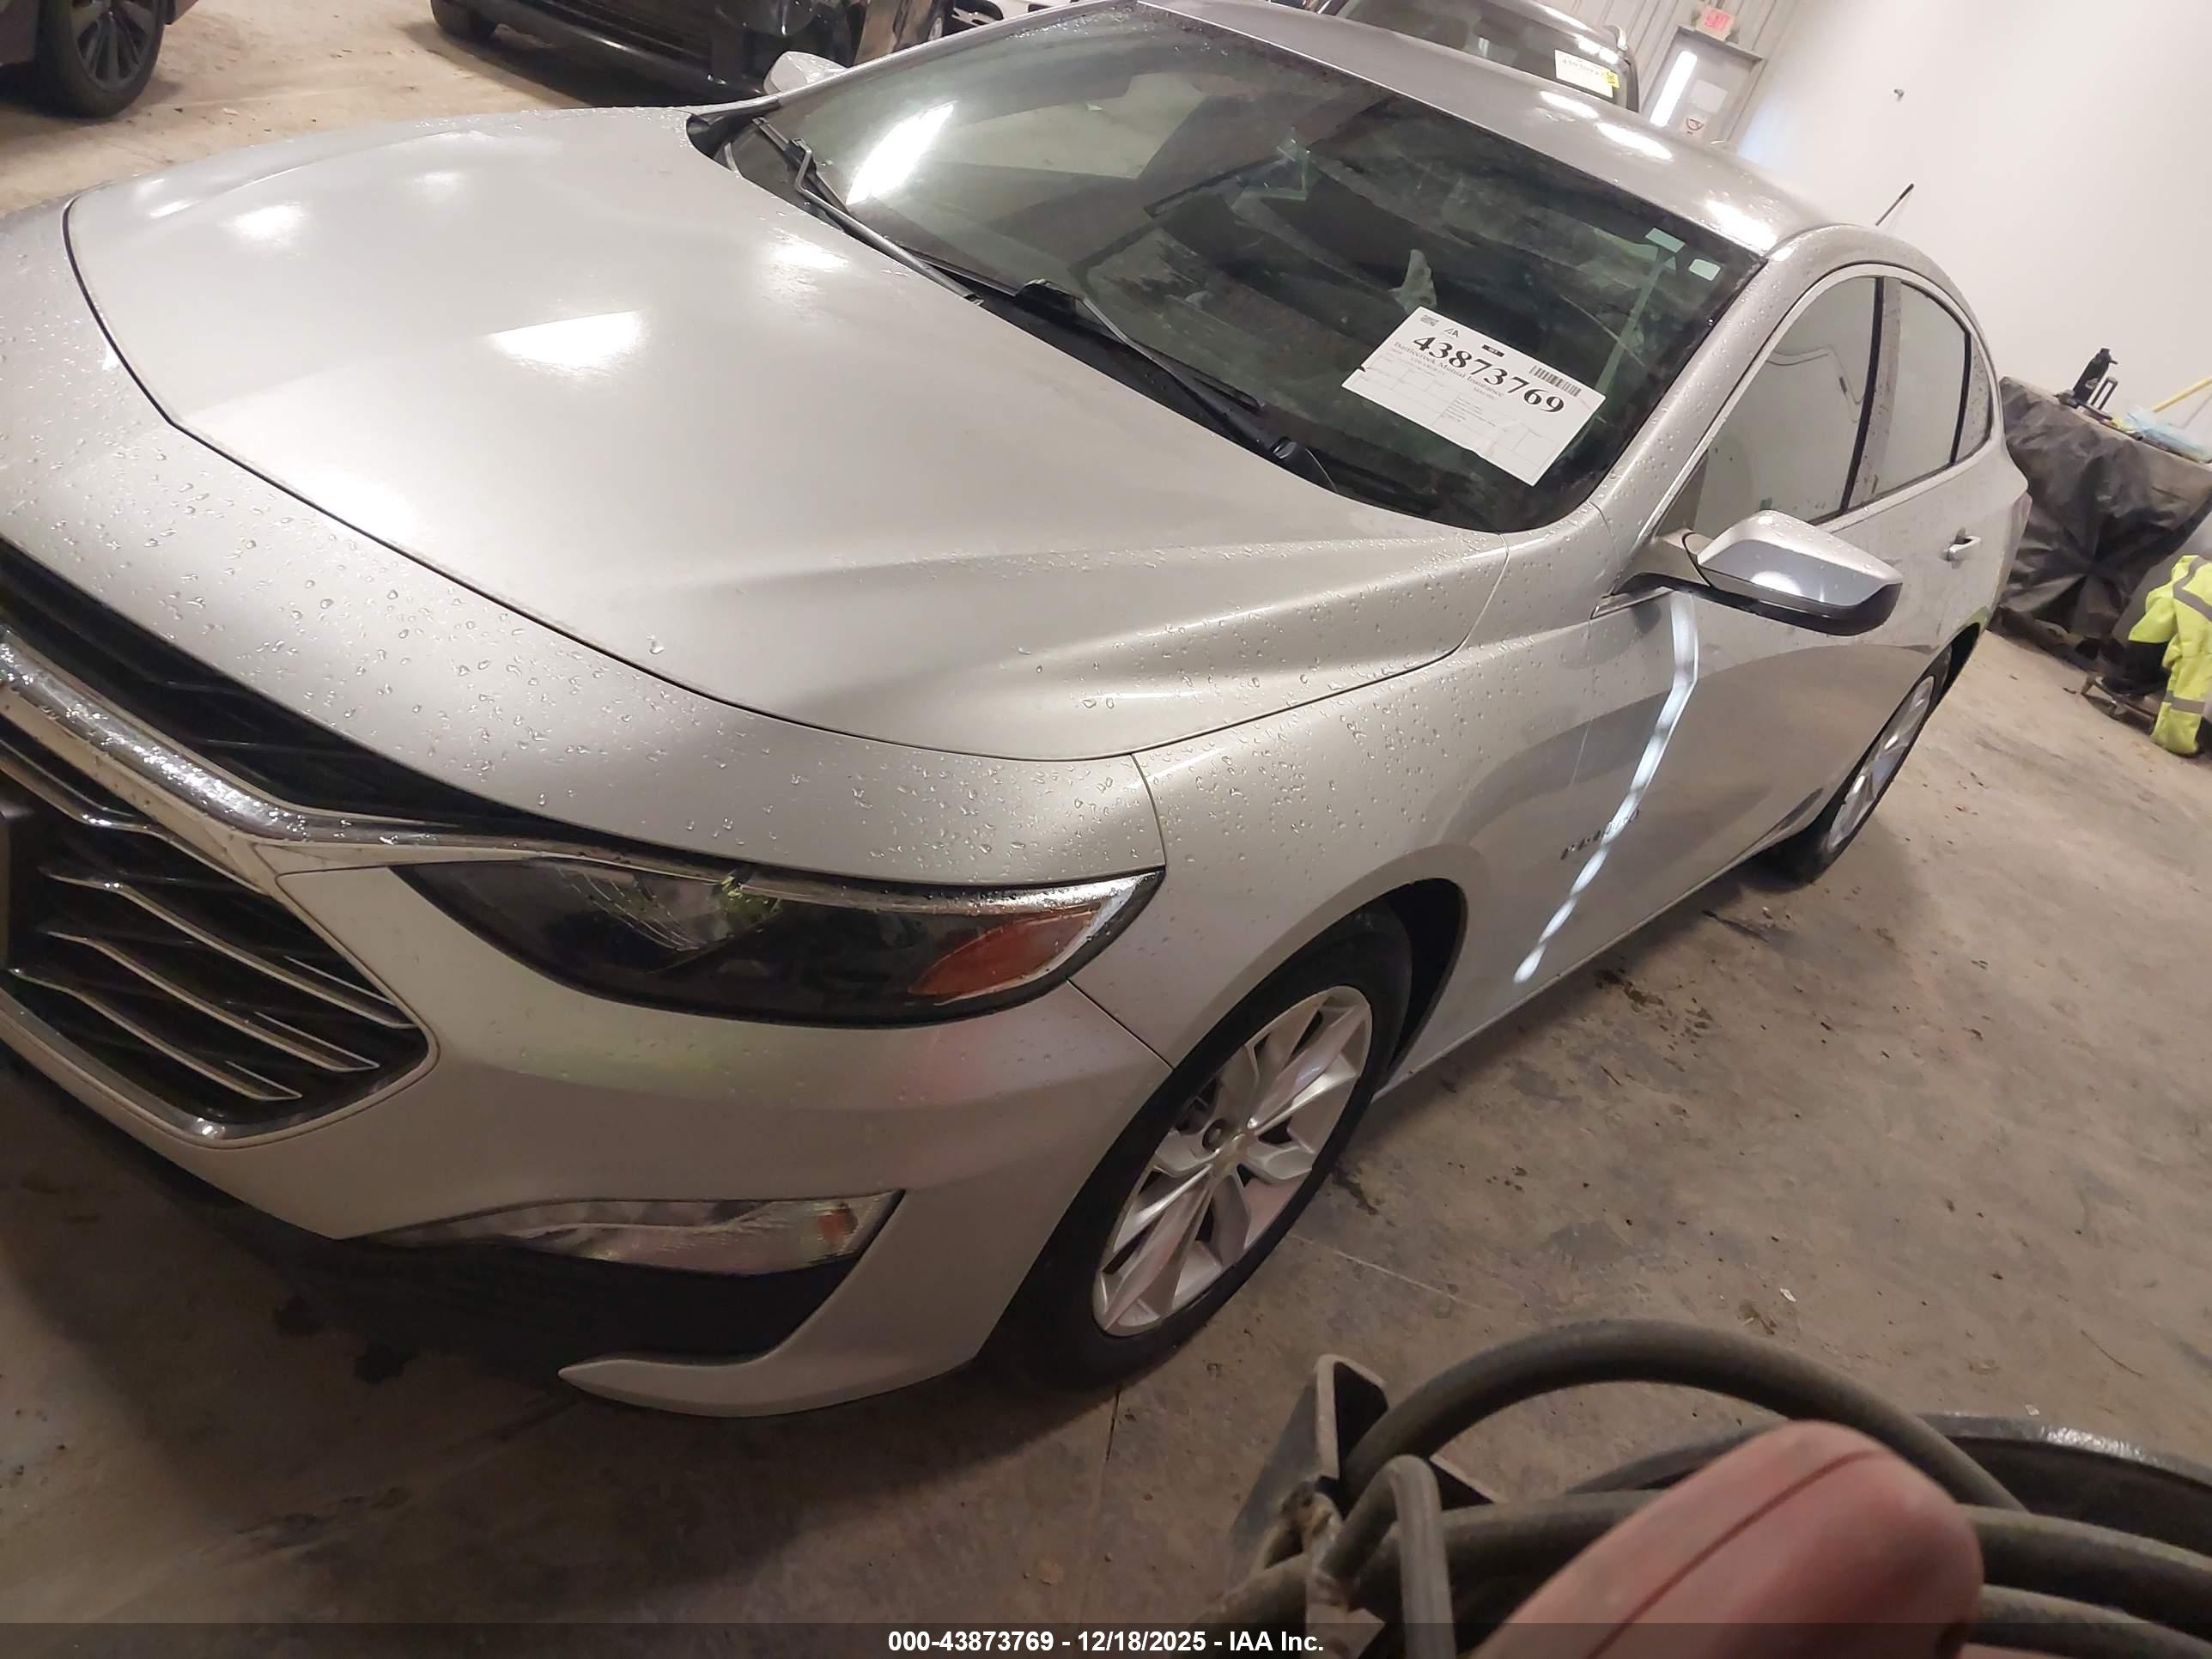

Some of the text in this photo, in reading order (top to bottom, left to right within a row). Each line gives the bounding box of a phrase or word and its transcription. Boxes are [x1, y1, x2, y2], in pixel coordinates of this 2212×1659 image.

[1413, 337, 1565, 413] 43873769
[1437, 362, 1467, 380] Mutual
[1467, 375, 1505, 398] Insurance
